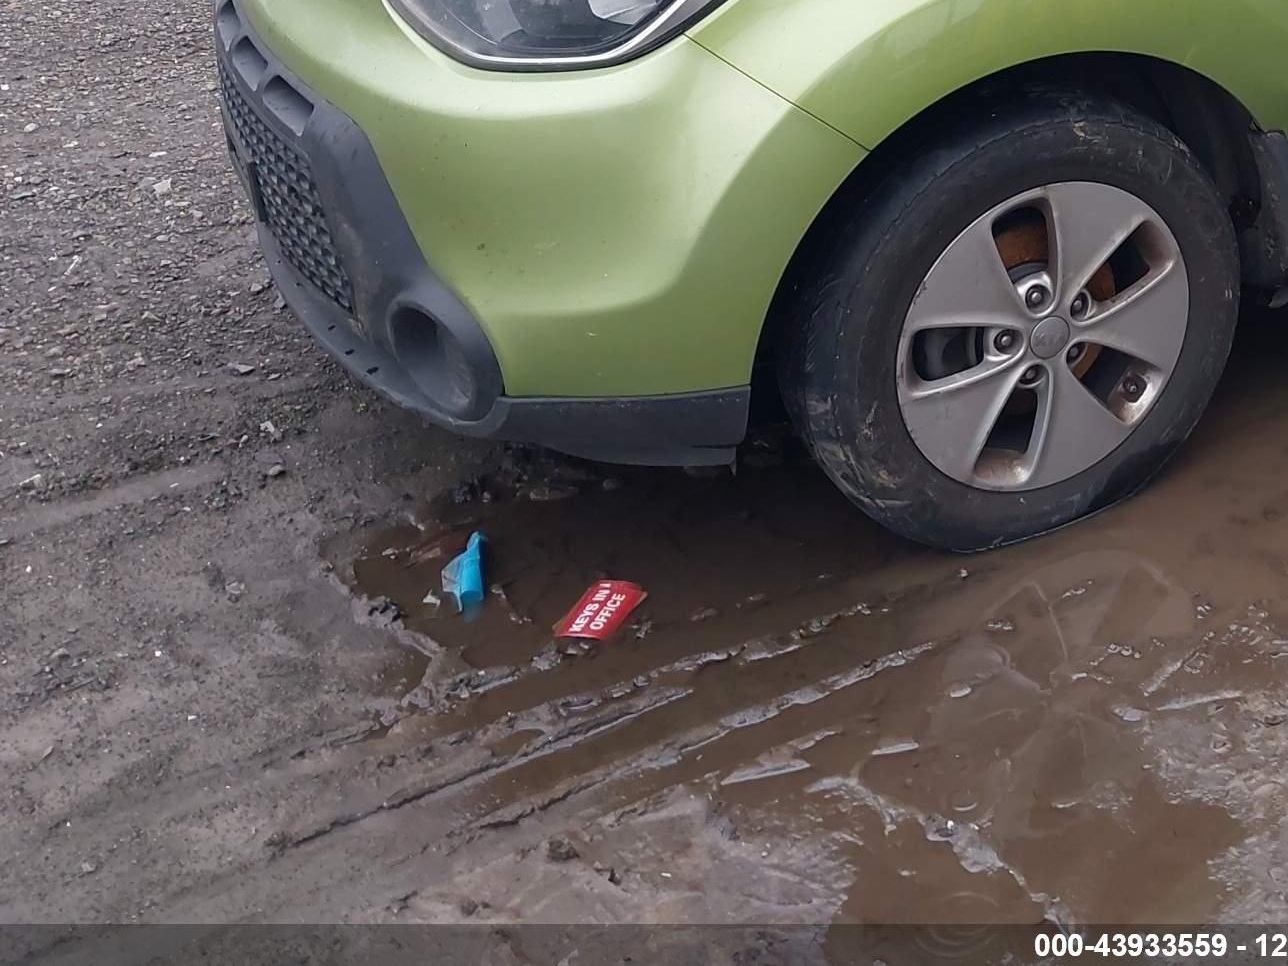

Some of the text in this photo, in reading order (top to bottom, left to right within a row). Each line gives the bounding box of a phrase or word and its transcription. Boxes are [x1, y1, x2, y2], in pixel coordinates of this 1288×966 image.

[568, 603, 600, 632] KEYS
[592, 589, 610, 601] IN
[589, 593, 626, 630] OFFICE
